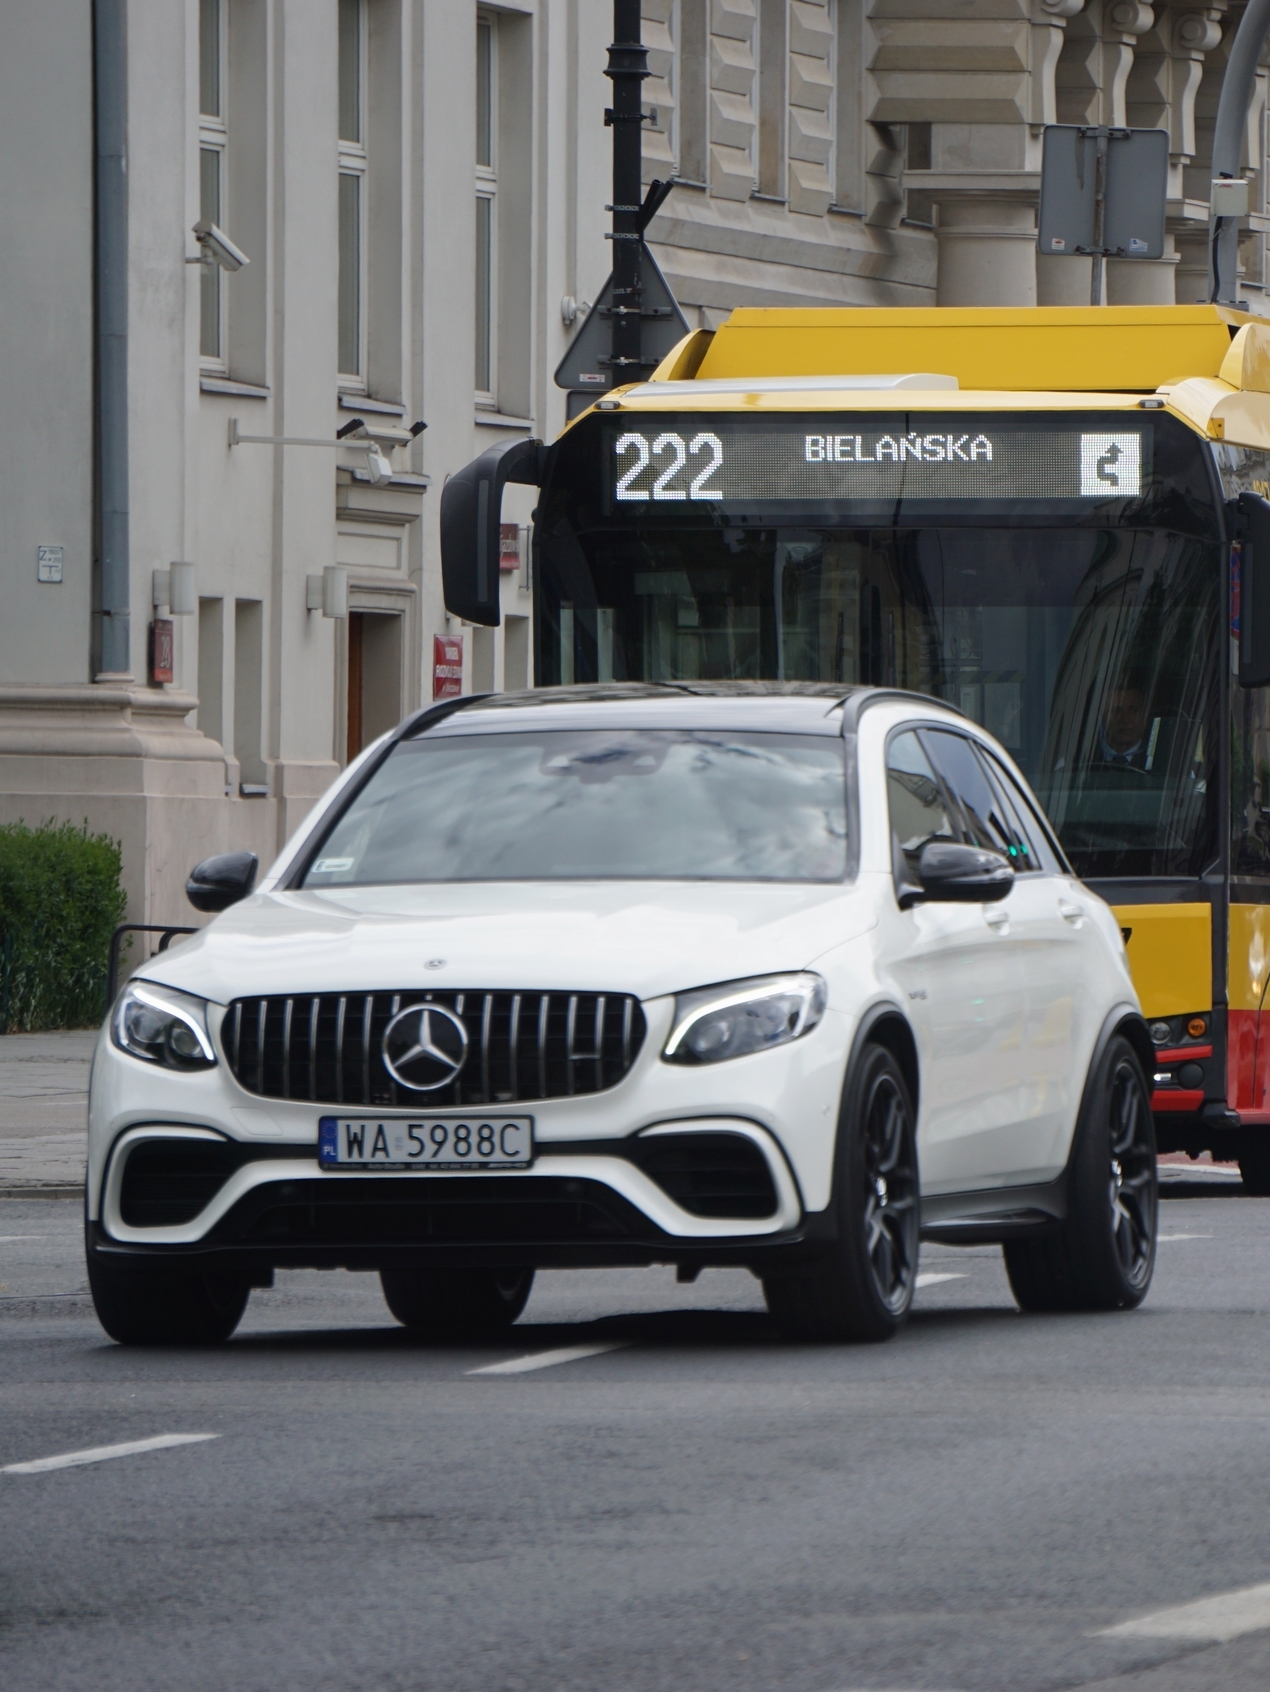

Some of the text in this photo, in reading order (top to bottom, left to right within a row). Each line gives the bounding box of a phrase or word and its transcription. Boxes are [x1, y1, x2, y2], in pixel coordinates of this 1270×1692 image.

[805, 432, 993, 461] BIELAŃSKA
[616, 432, 723, 500] 222
[323, 1145, 337, 1156] PL
[345, 1123, 521, 1159] WA 5988C
